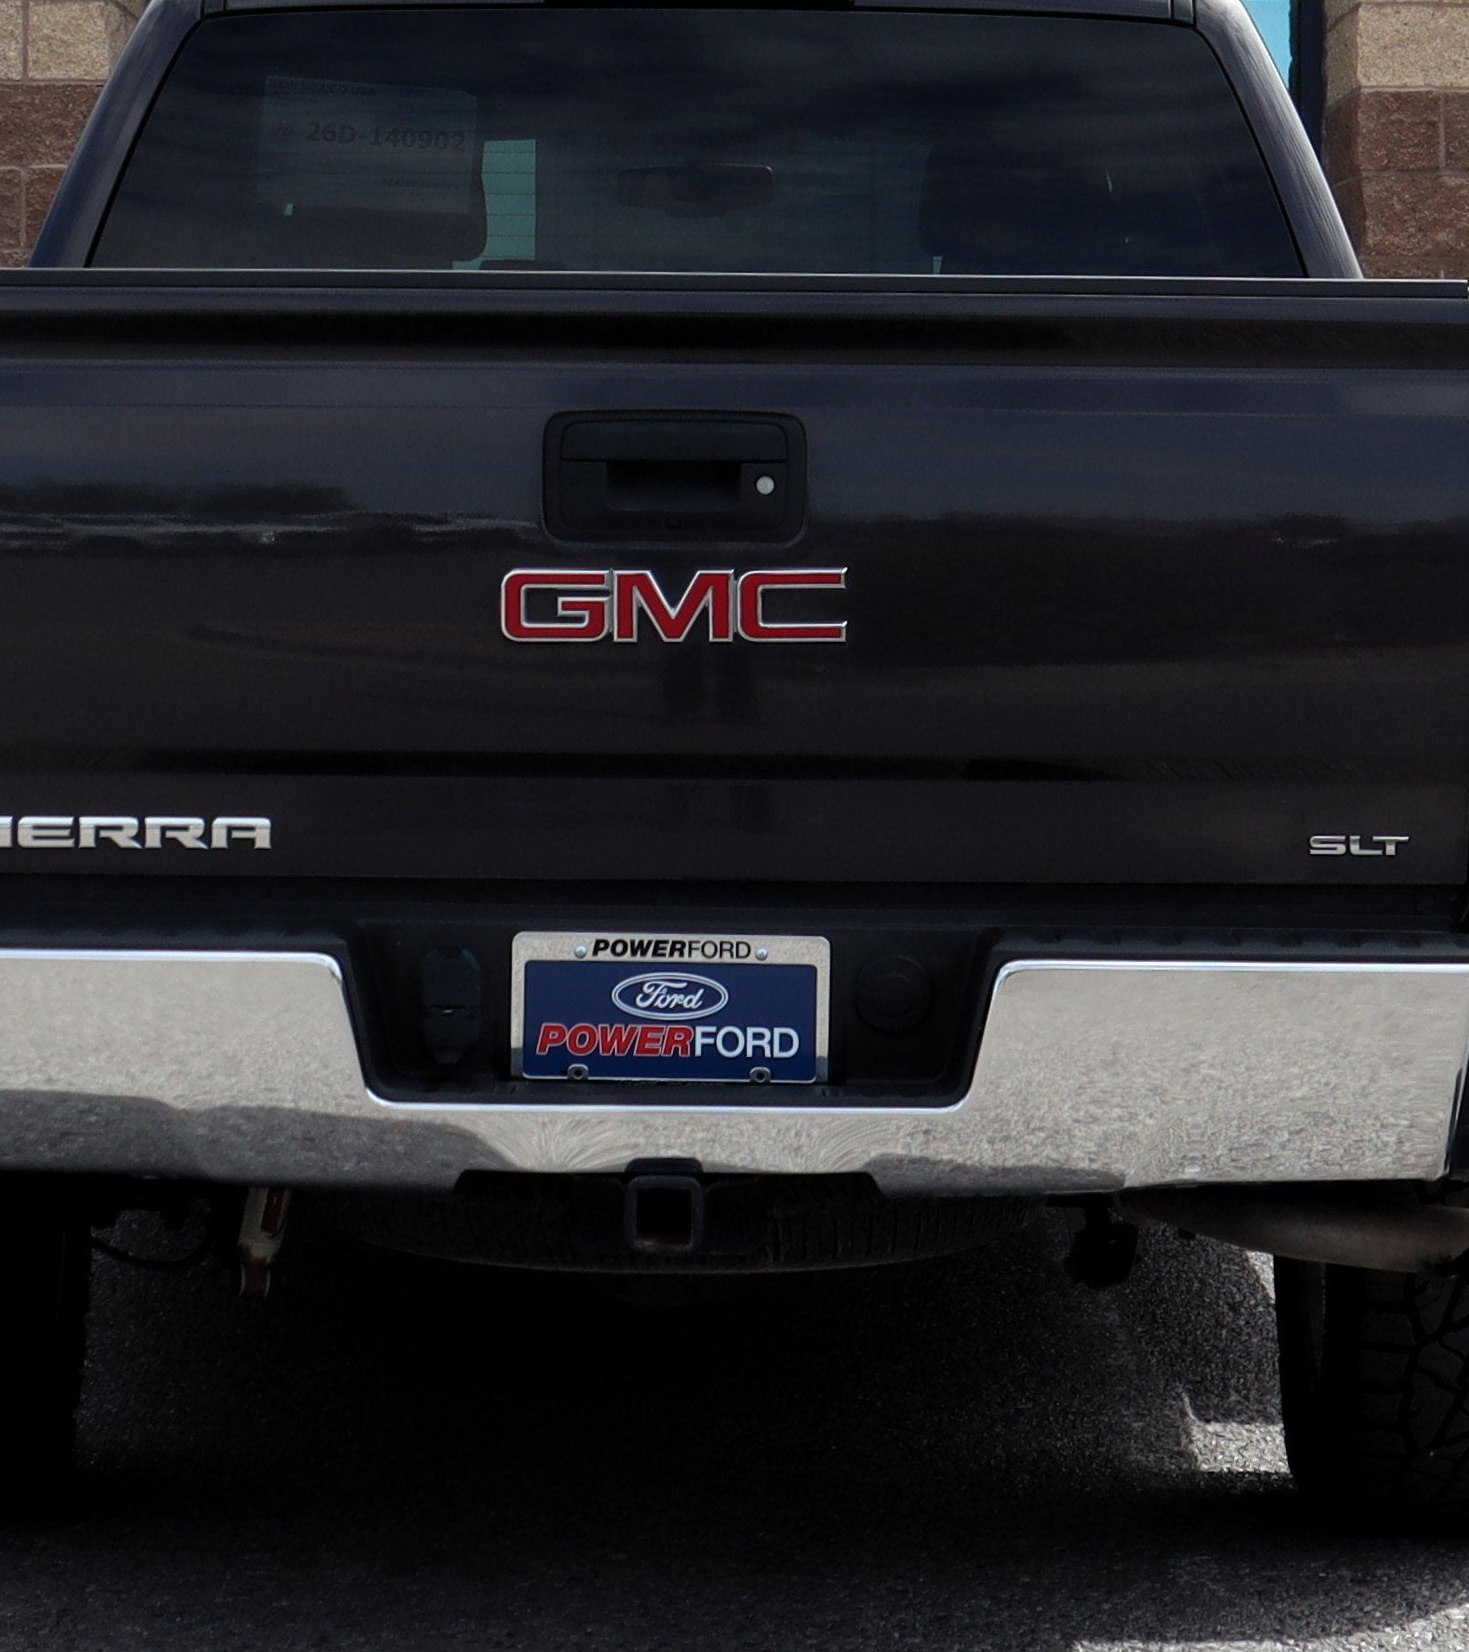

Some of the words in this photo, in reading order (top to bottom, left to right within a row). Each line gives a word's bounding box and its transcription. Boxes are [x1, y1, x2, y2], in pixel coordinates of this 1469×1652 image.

[305, 121, 466, 152] 26D-140902
[500, 566, 849, 643] GMC
[1309, 834, 1411, 857] SLT
[591, 938, 752, 960] POWERFORD
[635, 980, 704, 1010] Ford
[535, 1022, 800, 1059] POWERFORD
